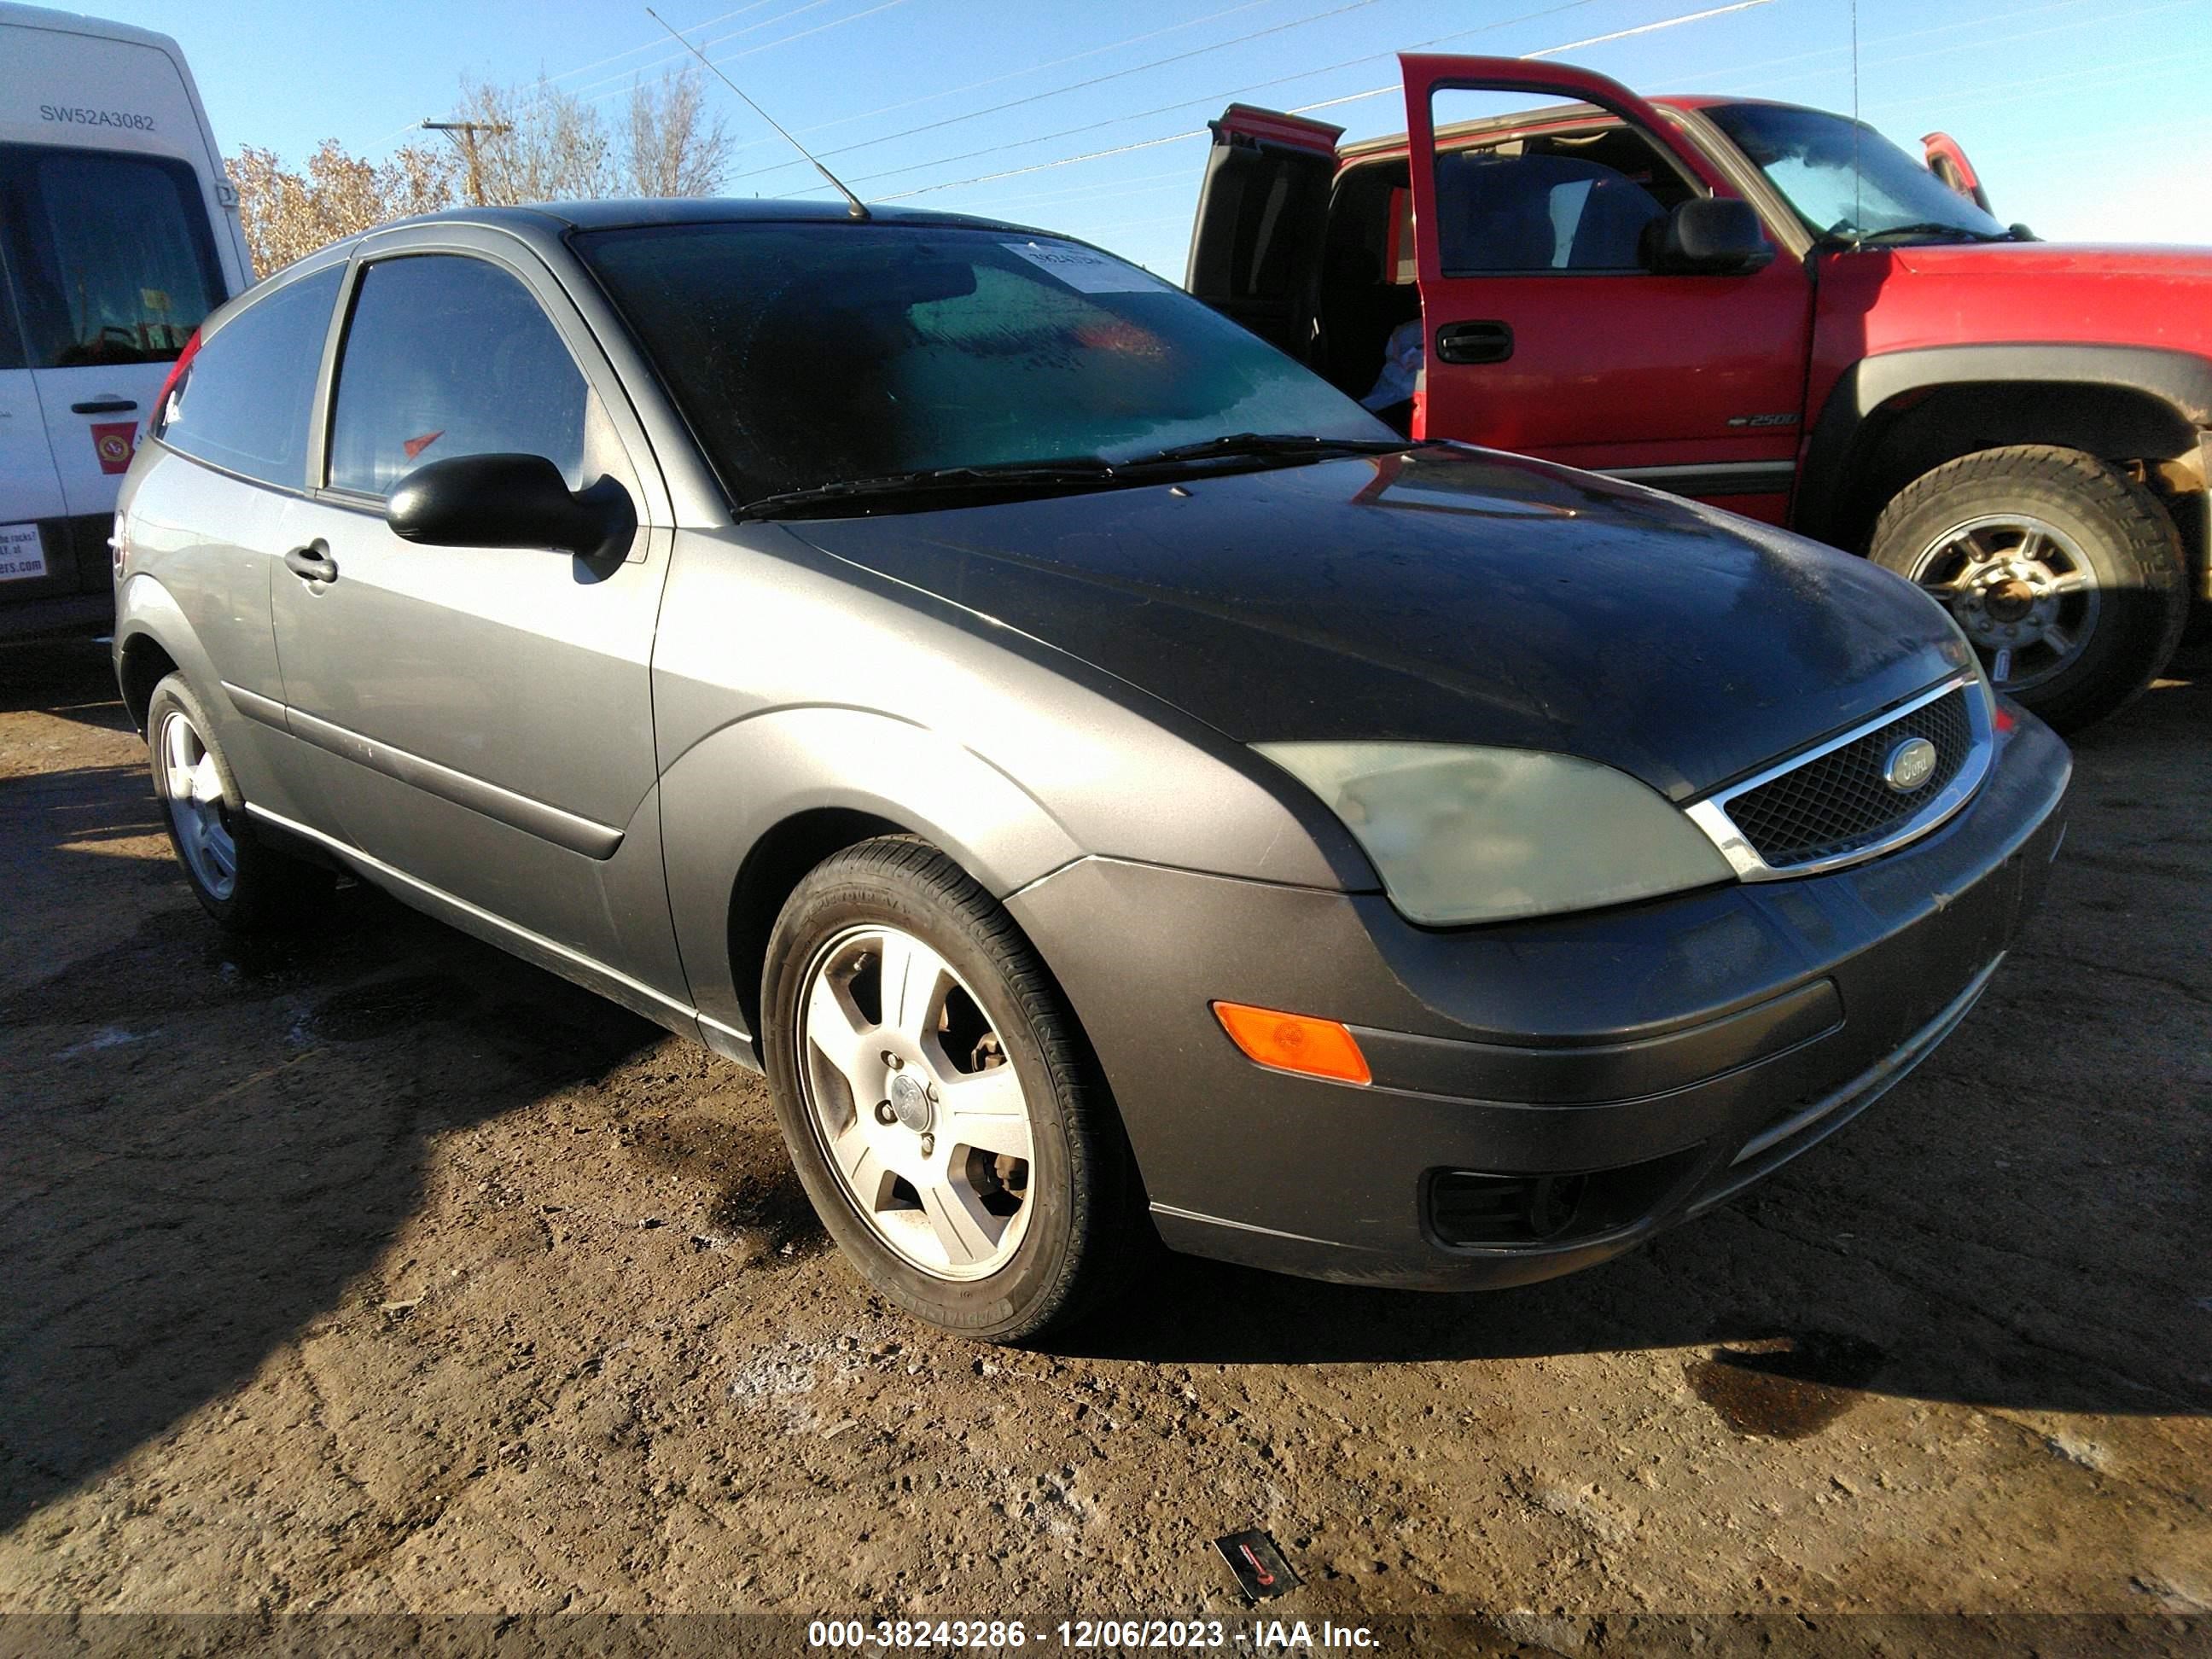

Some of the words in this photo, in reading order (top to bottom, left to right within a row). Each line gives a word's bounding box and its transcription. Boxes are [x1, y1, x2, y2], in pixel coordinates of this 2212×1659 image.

[40, 105, 156, 131] SW52A3082
[1749, 414, 1798, 426] 2500
[1902, 748, 1929, 781] Ford
